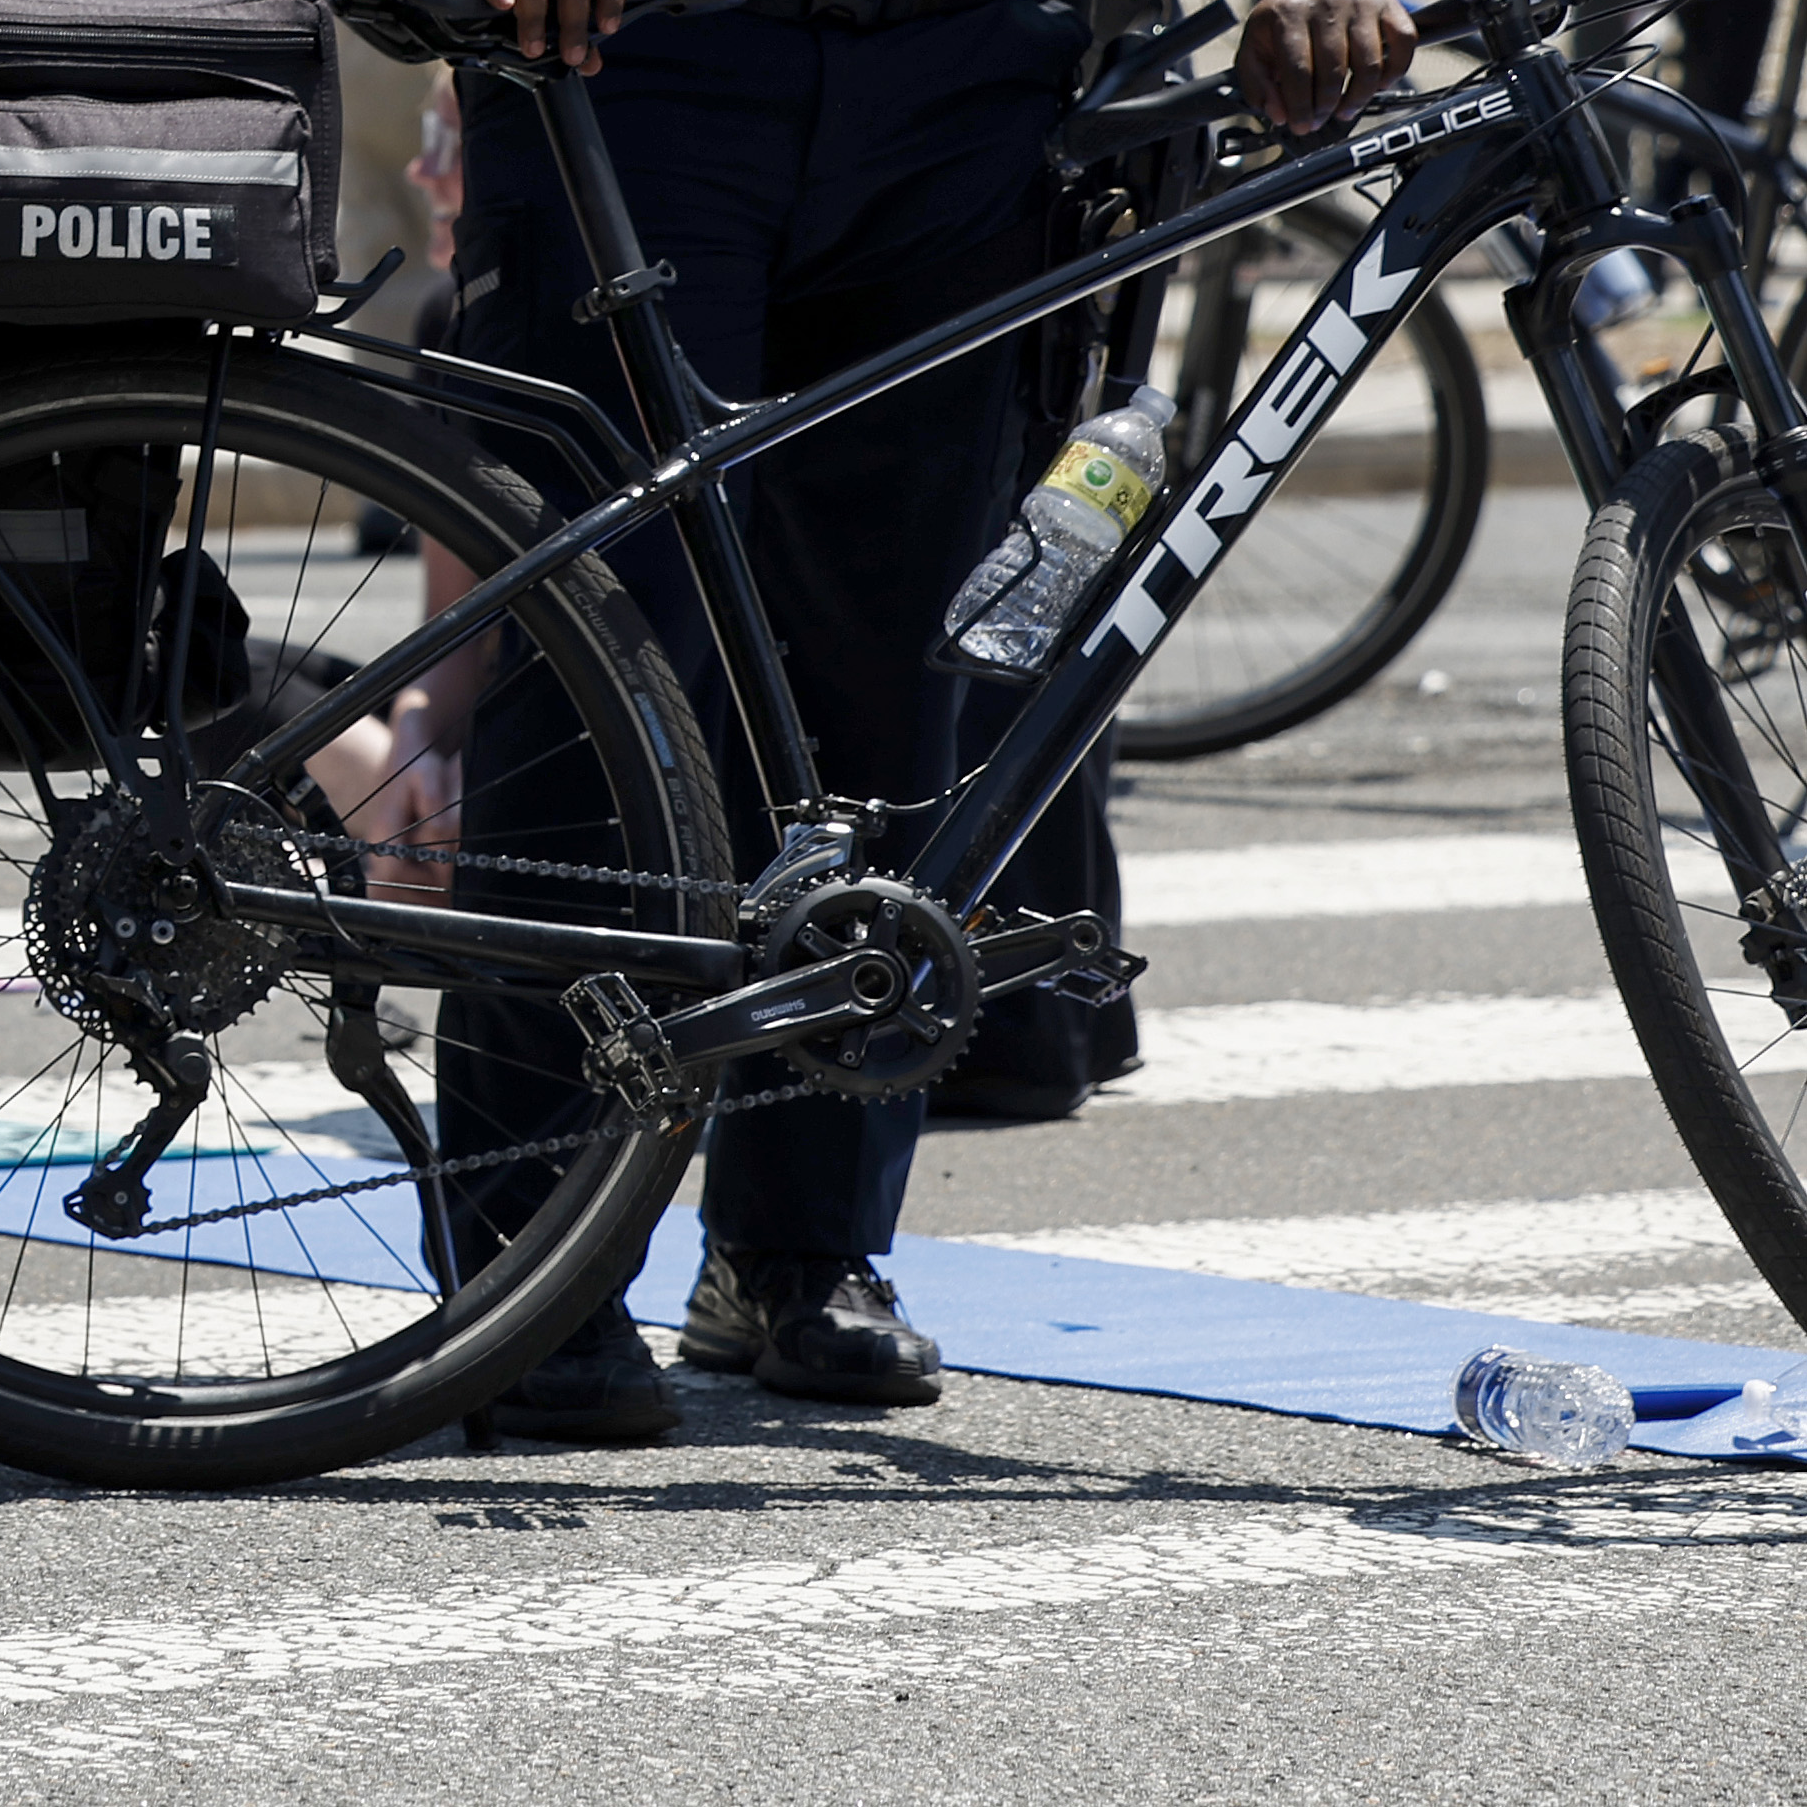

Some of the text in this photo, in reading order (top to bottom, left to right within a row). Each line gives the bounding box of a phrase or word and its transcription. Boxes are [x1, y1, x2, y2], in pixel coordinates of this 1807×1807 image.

[1349, 89, 1513, 167] POLICE
[21, 204, 212, 260] POLICE
[1081, 228, 1422, 657] TREK
[750, 998, 806, 1022] SHIMANO
